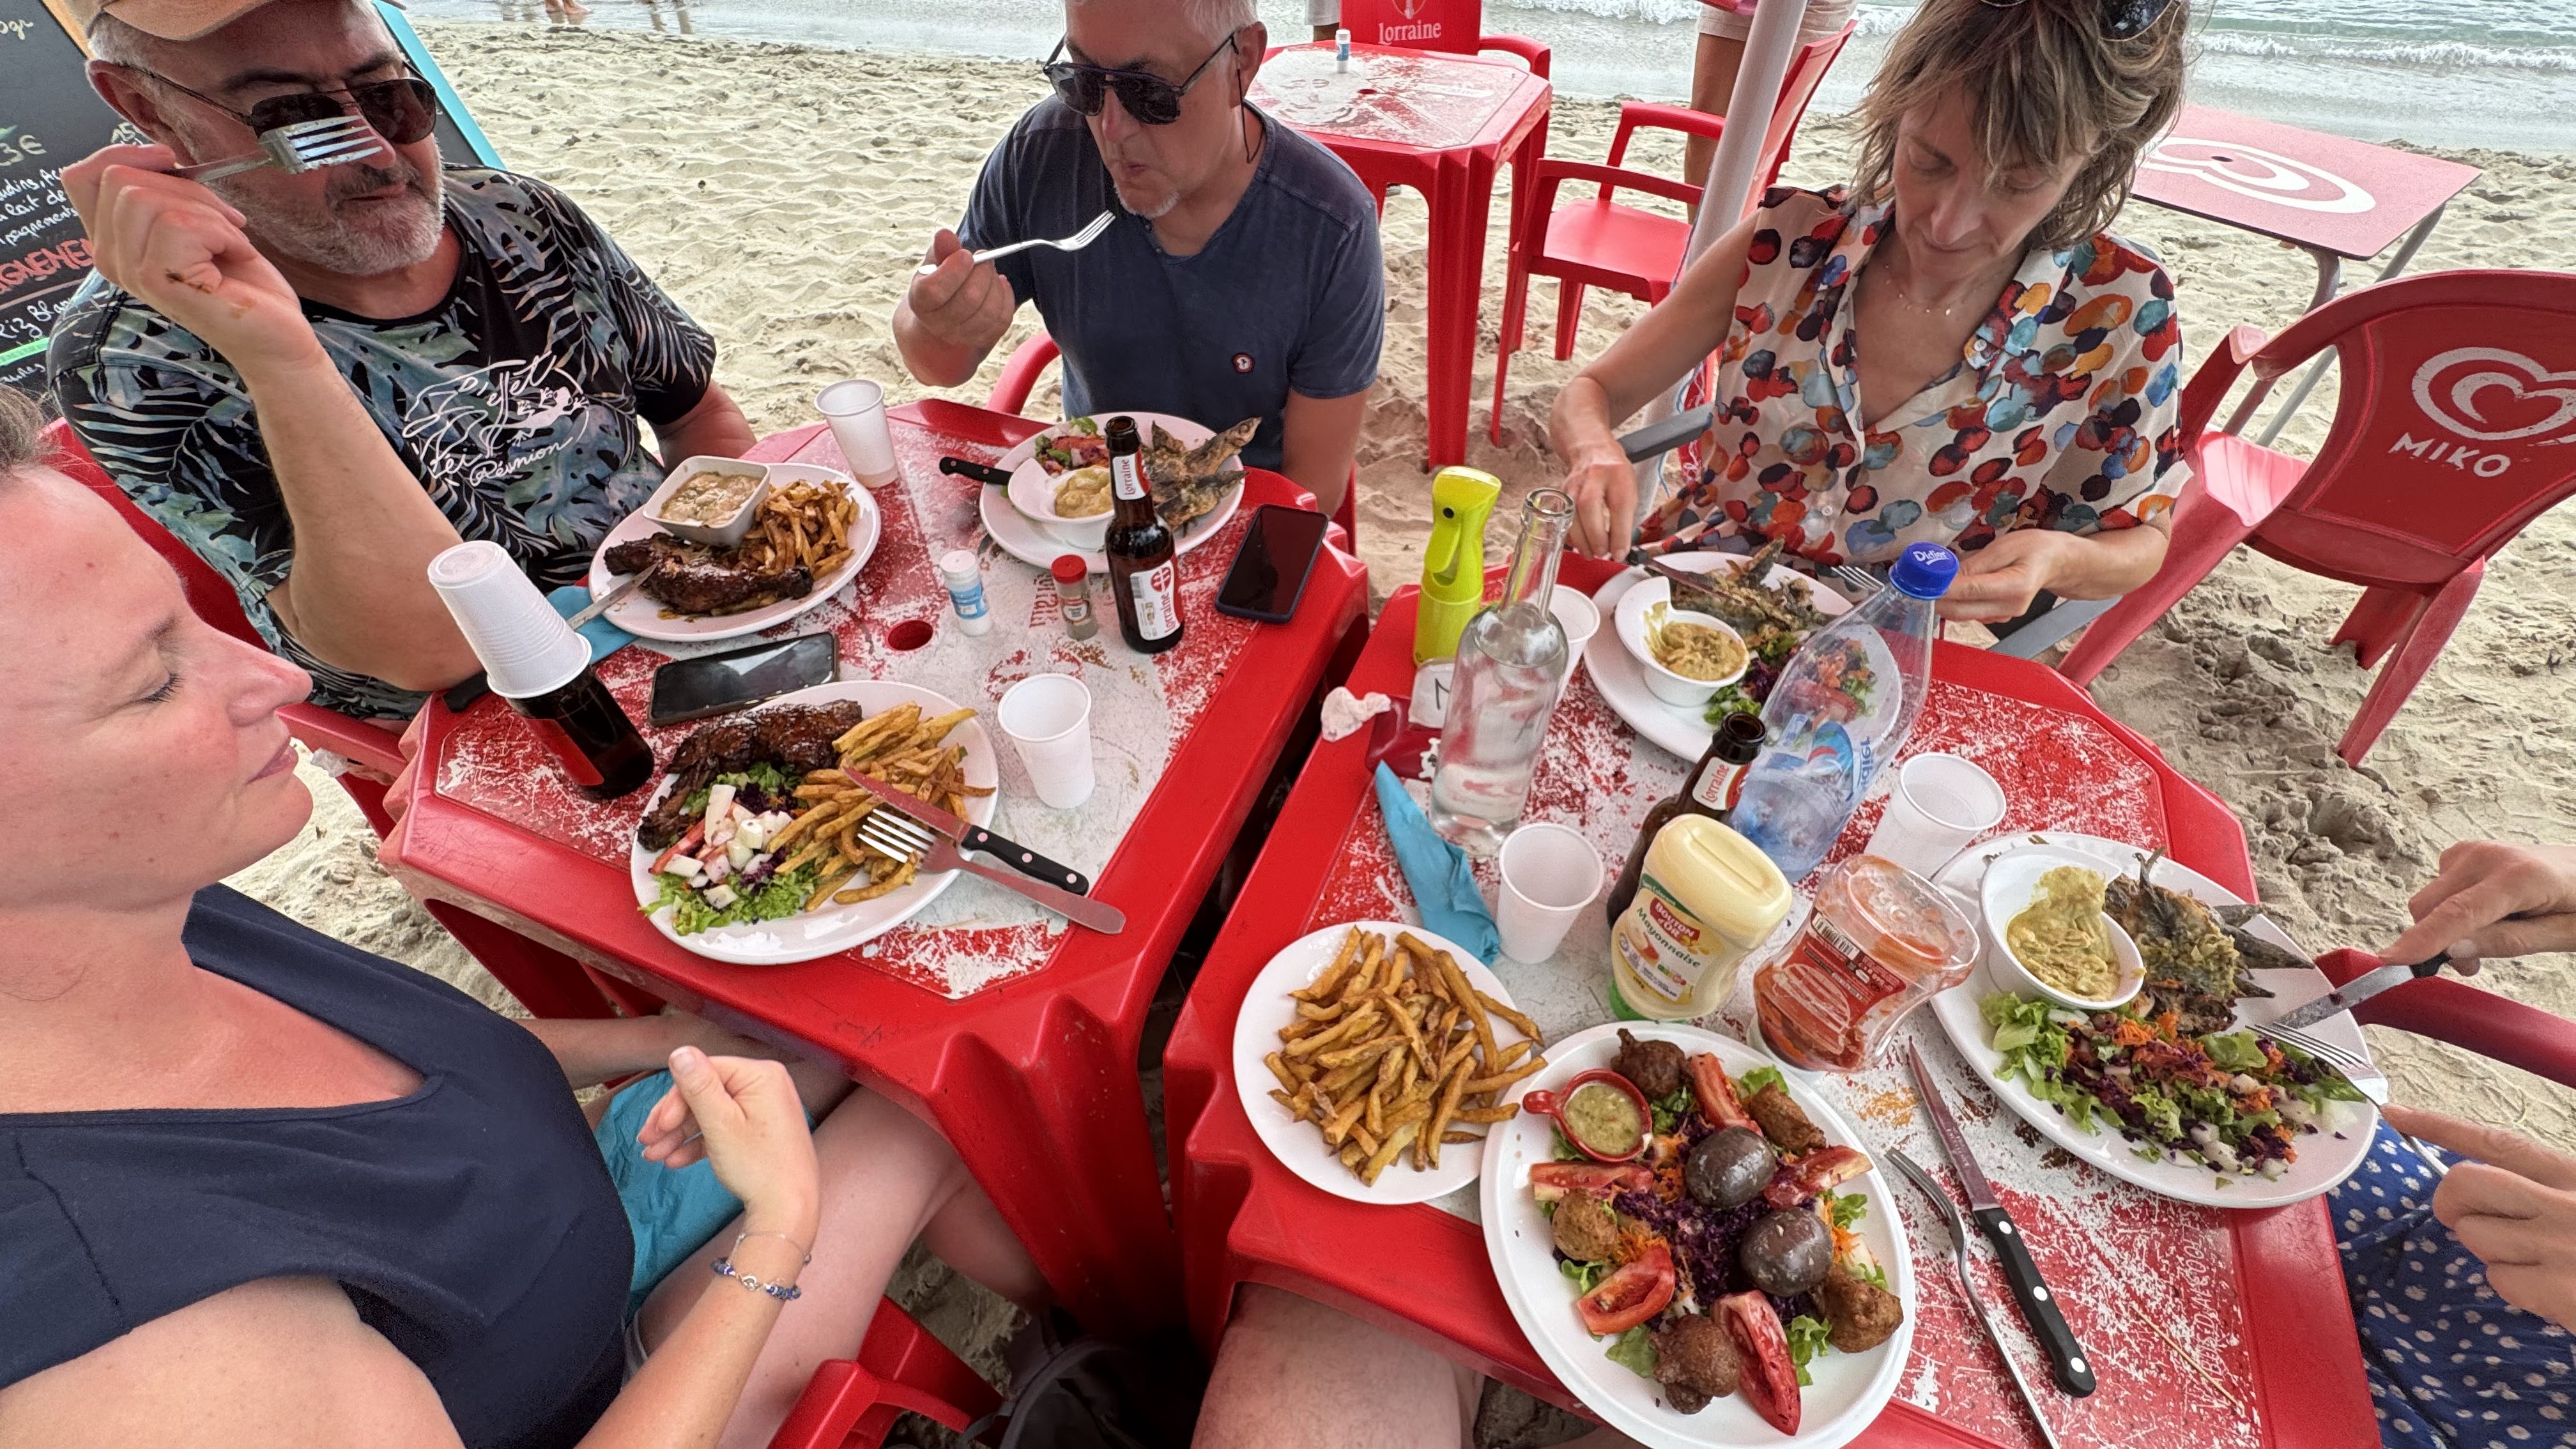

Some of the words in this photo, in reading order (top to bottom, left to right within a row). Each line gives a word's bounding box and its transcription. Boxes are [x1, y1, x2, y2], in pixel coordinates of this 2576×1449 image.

[1377, 20, 1442, 45] Lorraine
[47, 188, 66, 205] de
[470, 436, 573, 487] Réunion
[2388, 432, 2511, 478] MIKO
[1122, 459, 1137, 496] Lorraine
[1160, 592, 1177, 634] Lorraine
[1700, 763, 1730, 803] Lorraine
[1636, 907, 1701, 968] Mayonnaise
[1654, 901, 1694, 938] BOUTON
